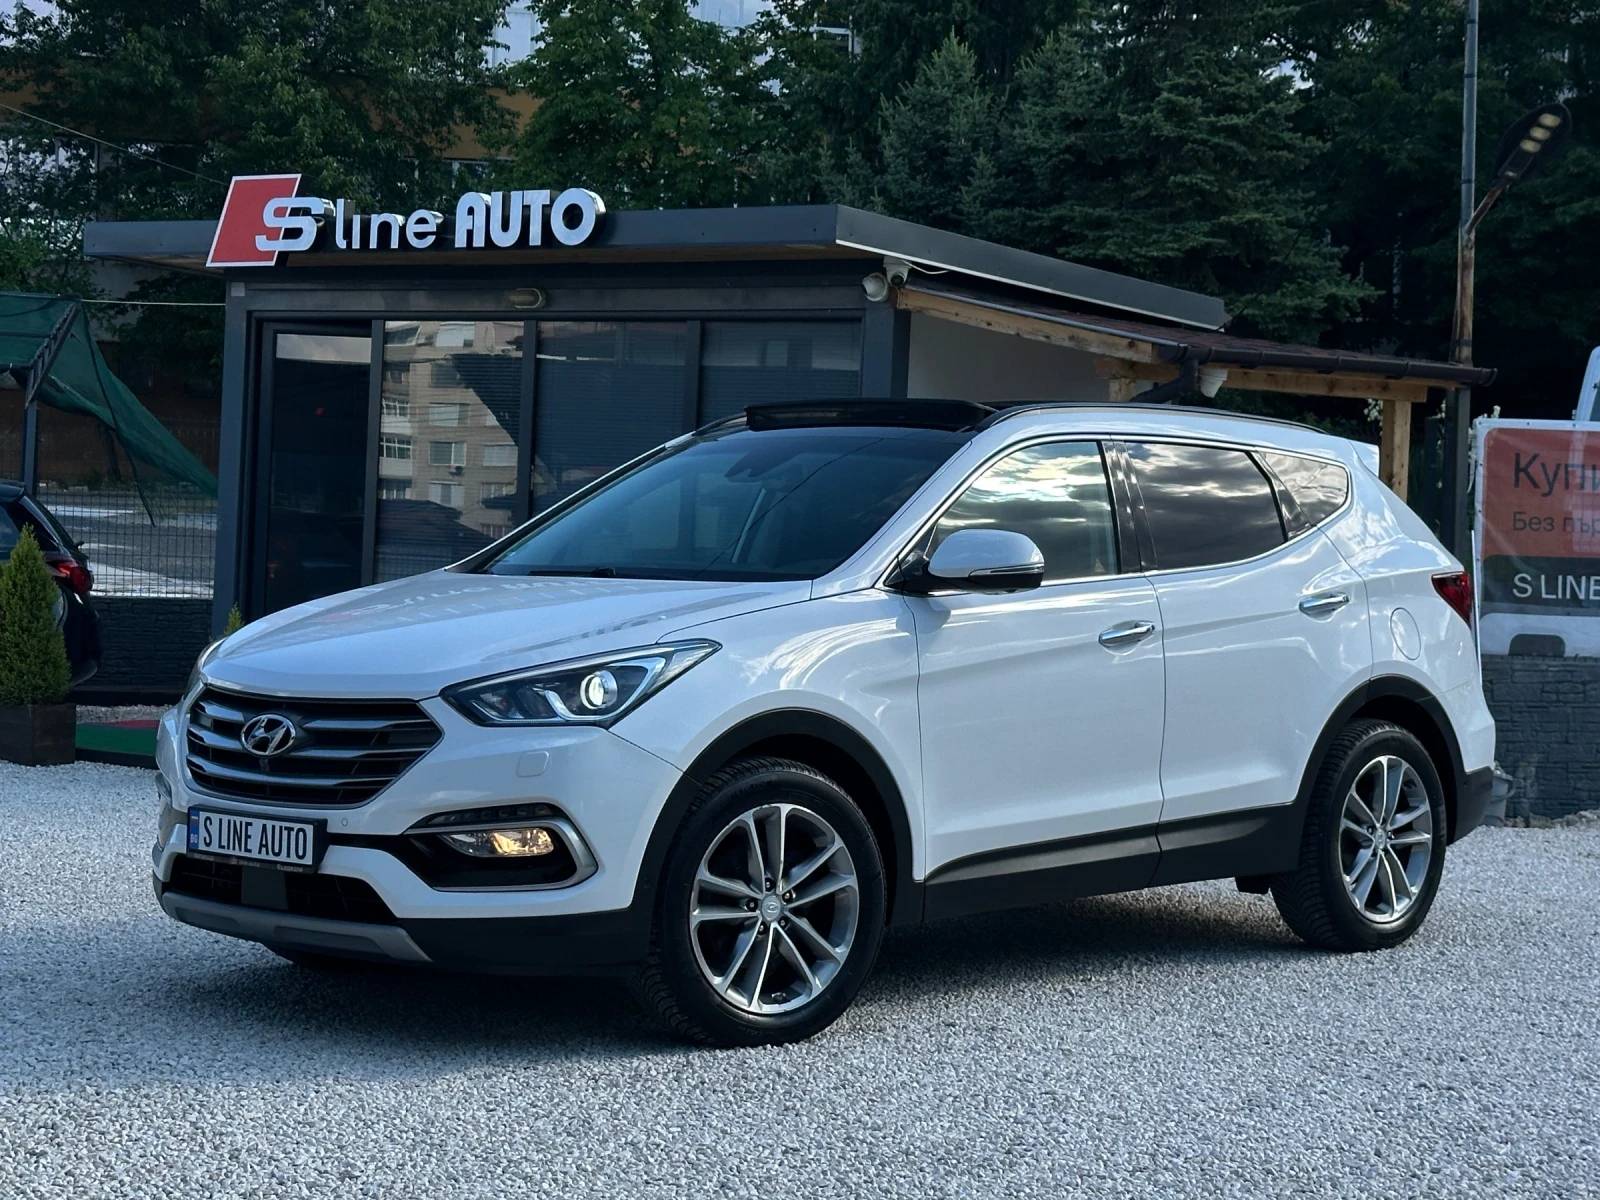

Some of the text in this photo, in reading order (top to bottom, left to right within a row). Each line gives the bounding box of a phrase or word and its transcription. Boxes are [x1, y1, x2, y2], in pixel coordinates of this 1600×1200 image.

[255, 187, 600, 252] S line AUTO
[1512, 511, 1555, 532] Без
[1512, 573, 1600, 600] S LINE
[203, 815, 308, 860] S LINE AUTO
